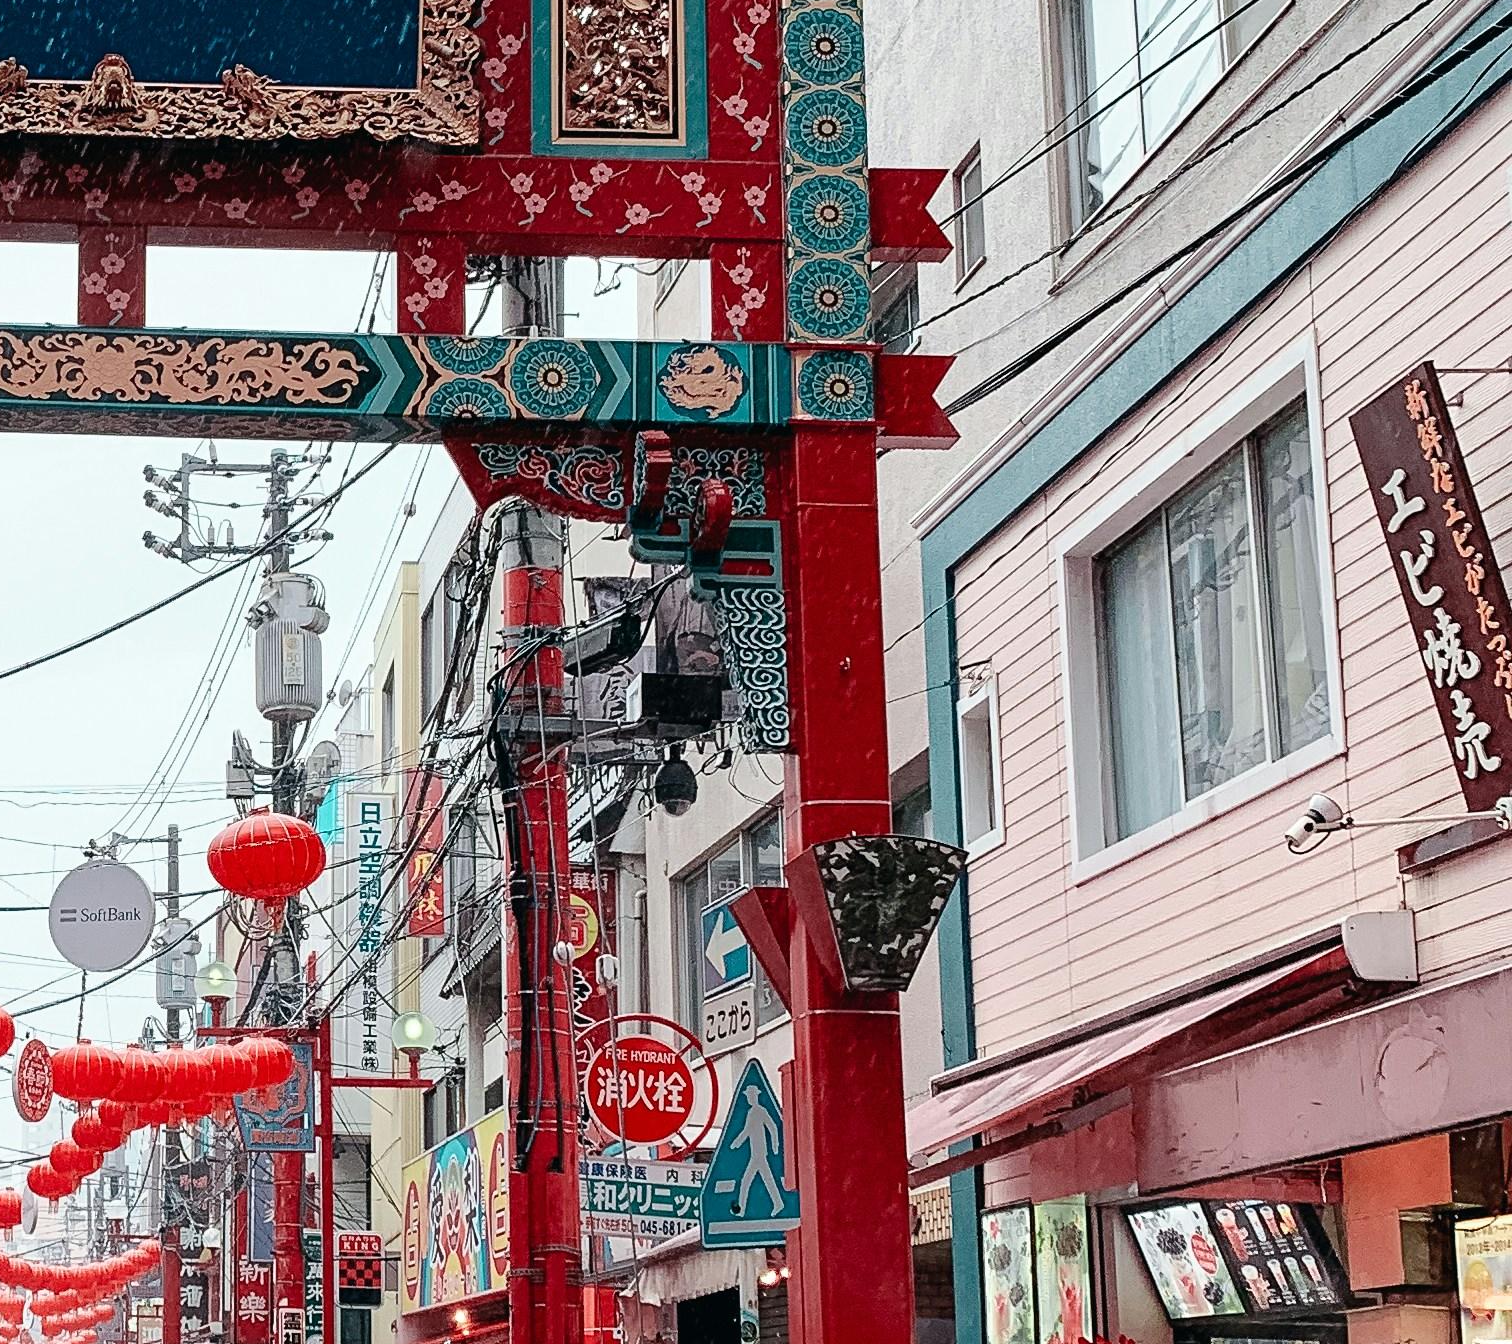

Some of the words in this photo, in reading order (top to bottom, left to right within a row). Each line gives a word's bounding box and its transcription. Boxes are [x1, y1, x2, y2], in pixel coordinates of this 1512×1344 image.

[1381, 468, 1502, 779] エビ焼売
[80, 907, 142, 922] SoftBank
[705, 999, 752, 1044] ここから
[630, 1050, 677, 1065] HYDRANT
[596, 1066, 687, 1113] 消火栓
[343, 1242, 379, 1252] KING
